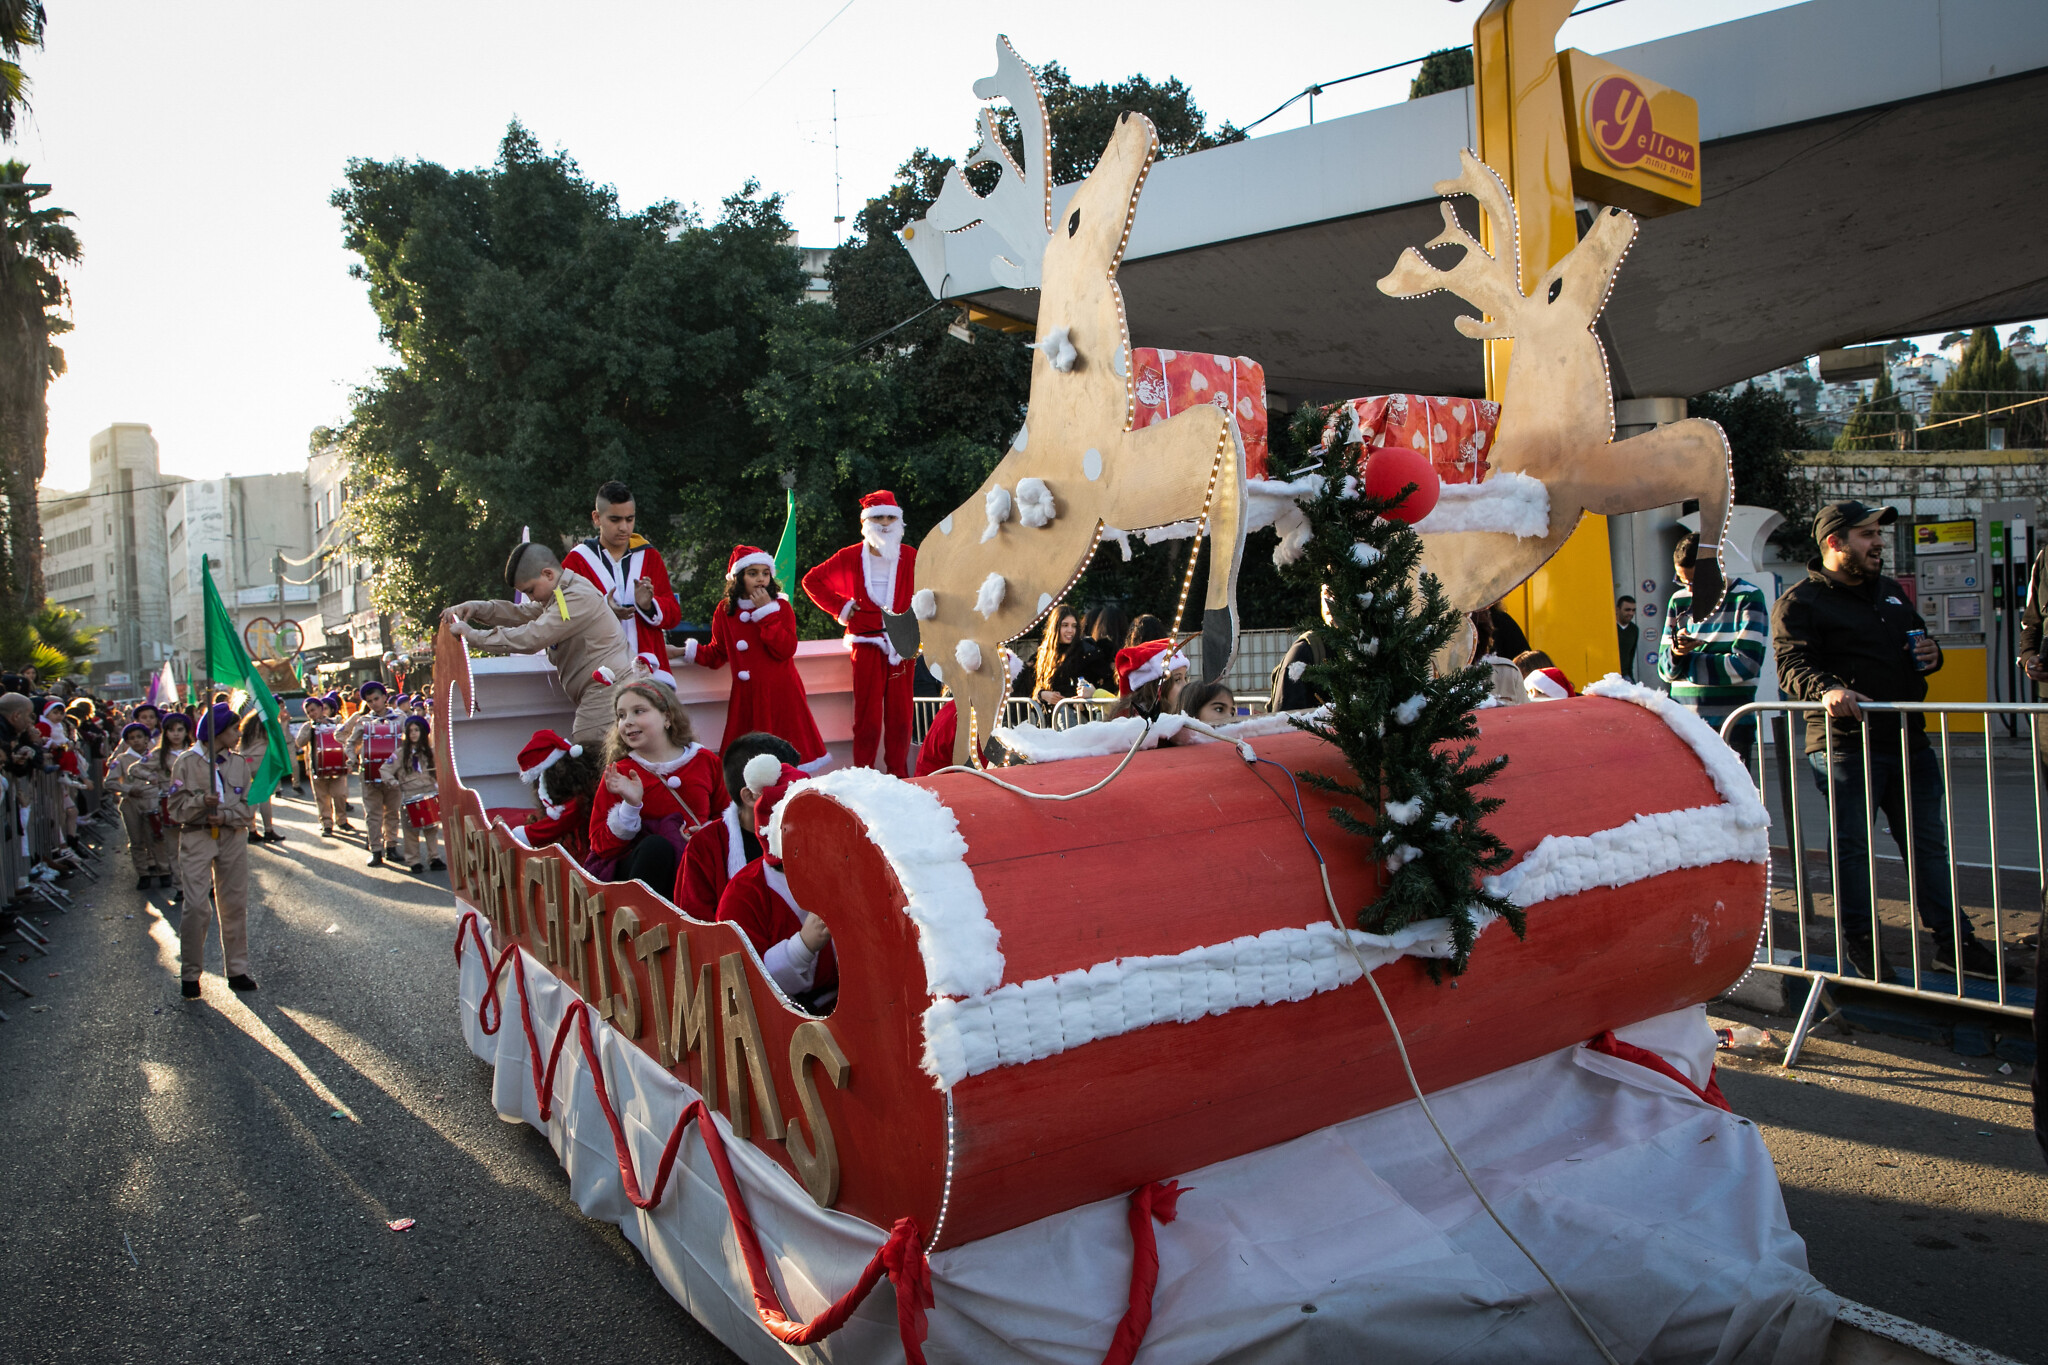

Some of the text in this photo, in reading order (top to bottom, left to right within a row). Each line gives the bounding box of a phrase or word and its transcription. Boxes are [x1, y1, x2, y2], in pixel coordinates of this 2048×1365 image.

[1644, 157, 1693, 180] חנויות נוחות
[449, 805, 850, 1208] MERRY CHRISTMAS
